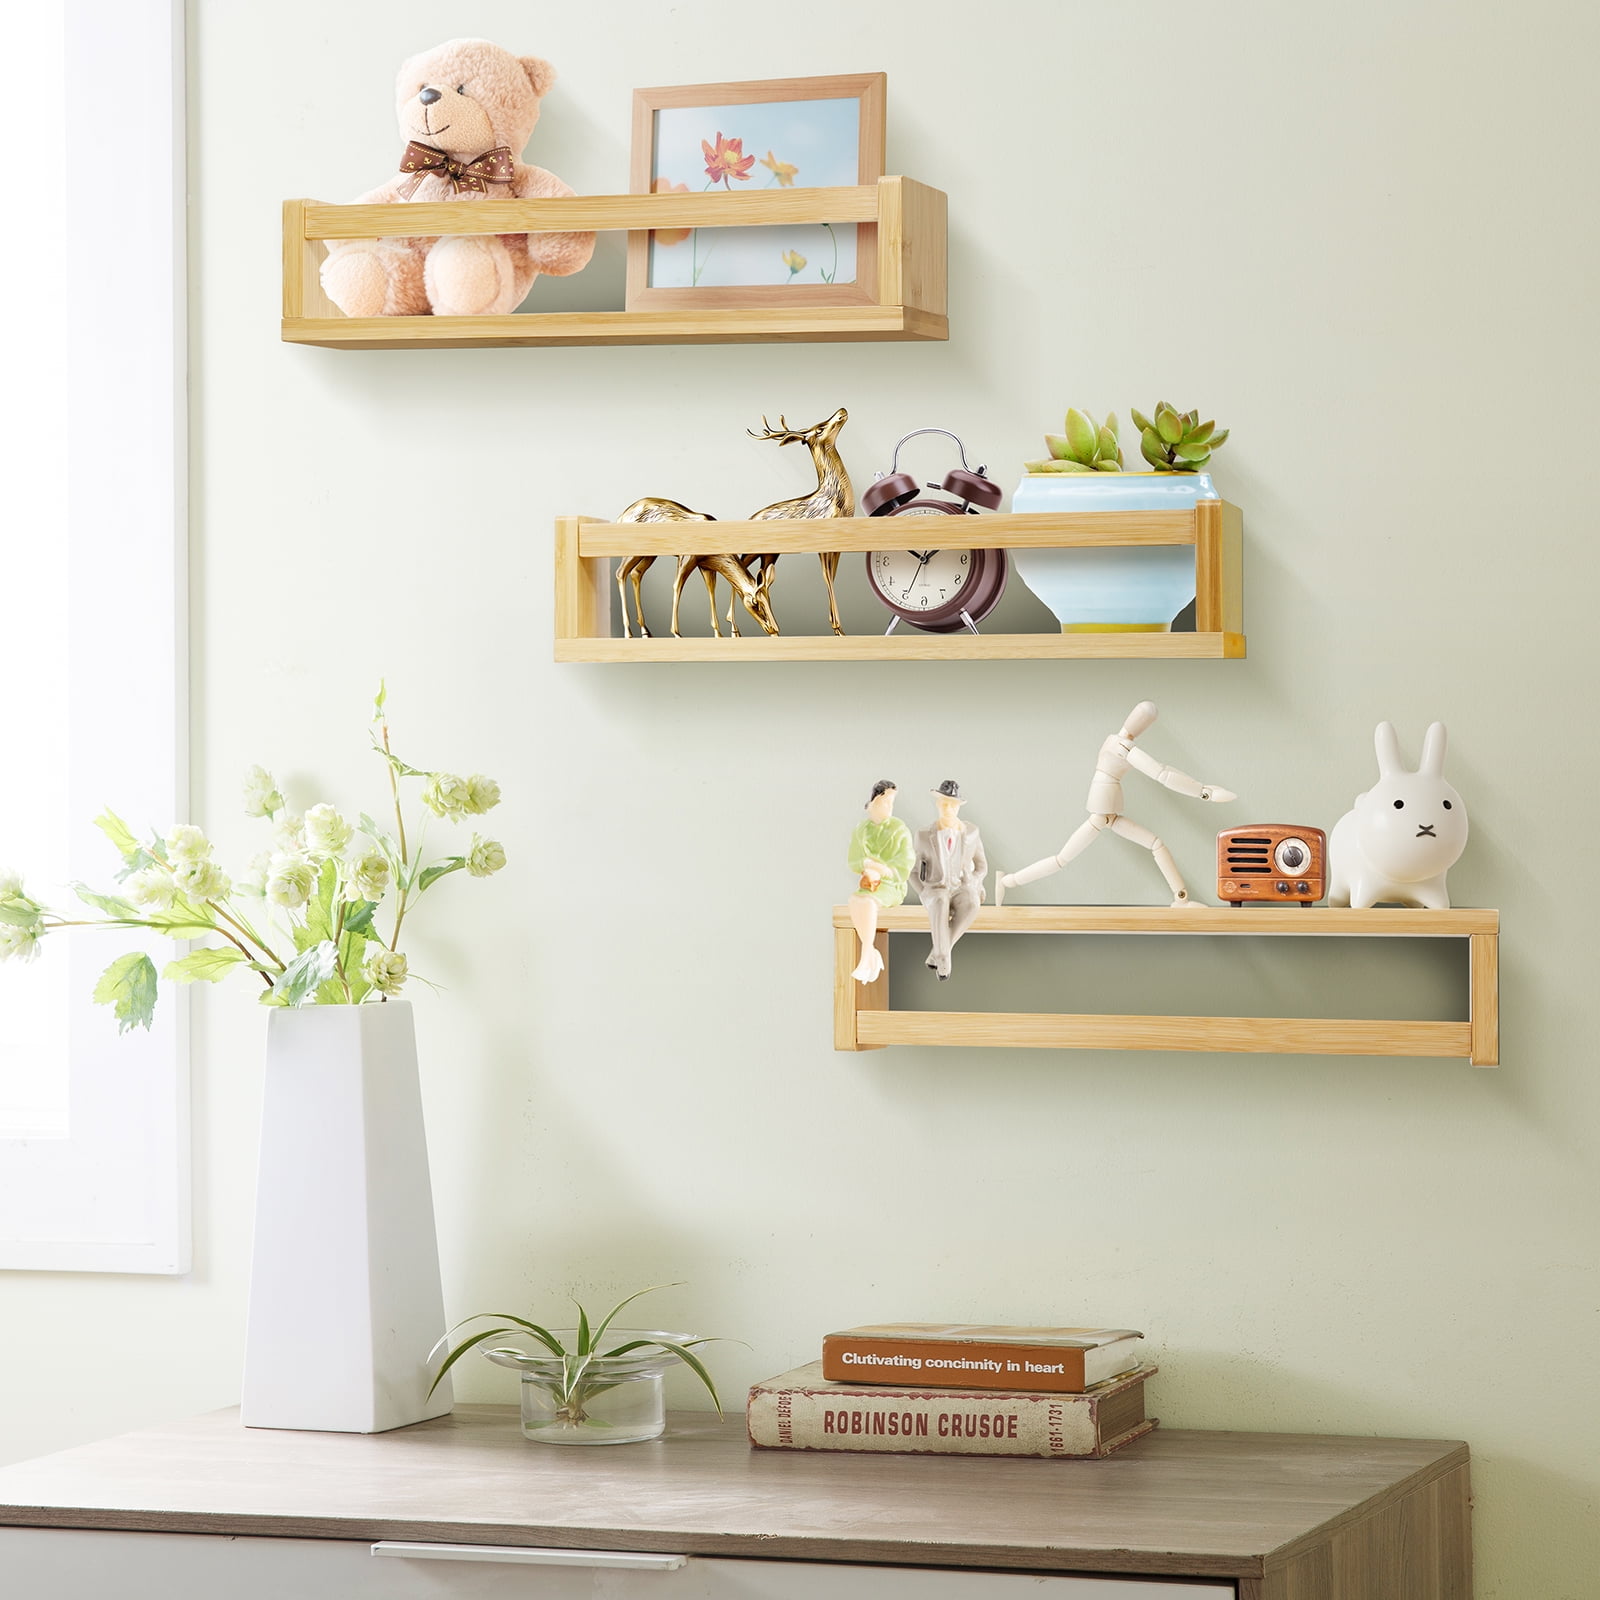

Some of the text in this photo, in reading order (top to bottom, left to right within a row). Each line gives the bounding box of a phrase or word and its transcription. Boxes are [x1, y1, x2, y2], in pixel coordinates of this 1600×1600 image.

[842, 1352, 1064, 1374] Clutivating concinnity in heart
[778, 1396, 793, 1443] DANIEL DEFOE
[824, 1410, 1018, 1438] ROBINSON CRUSOE
